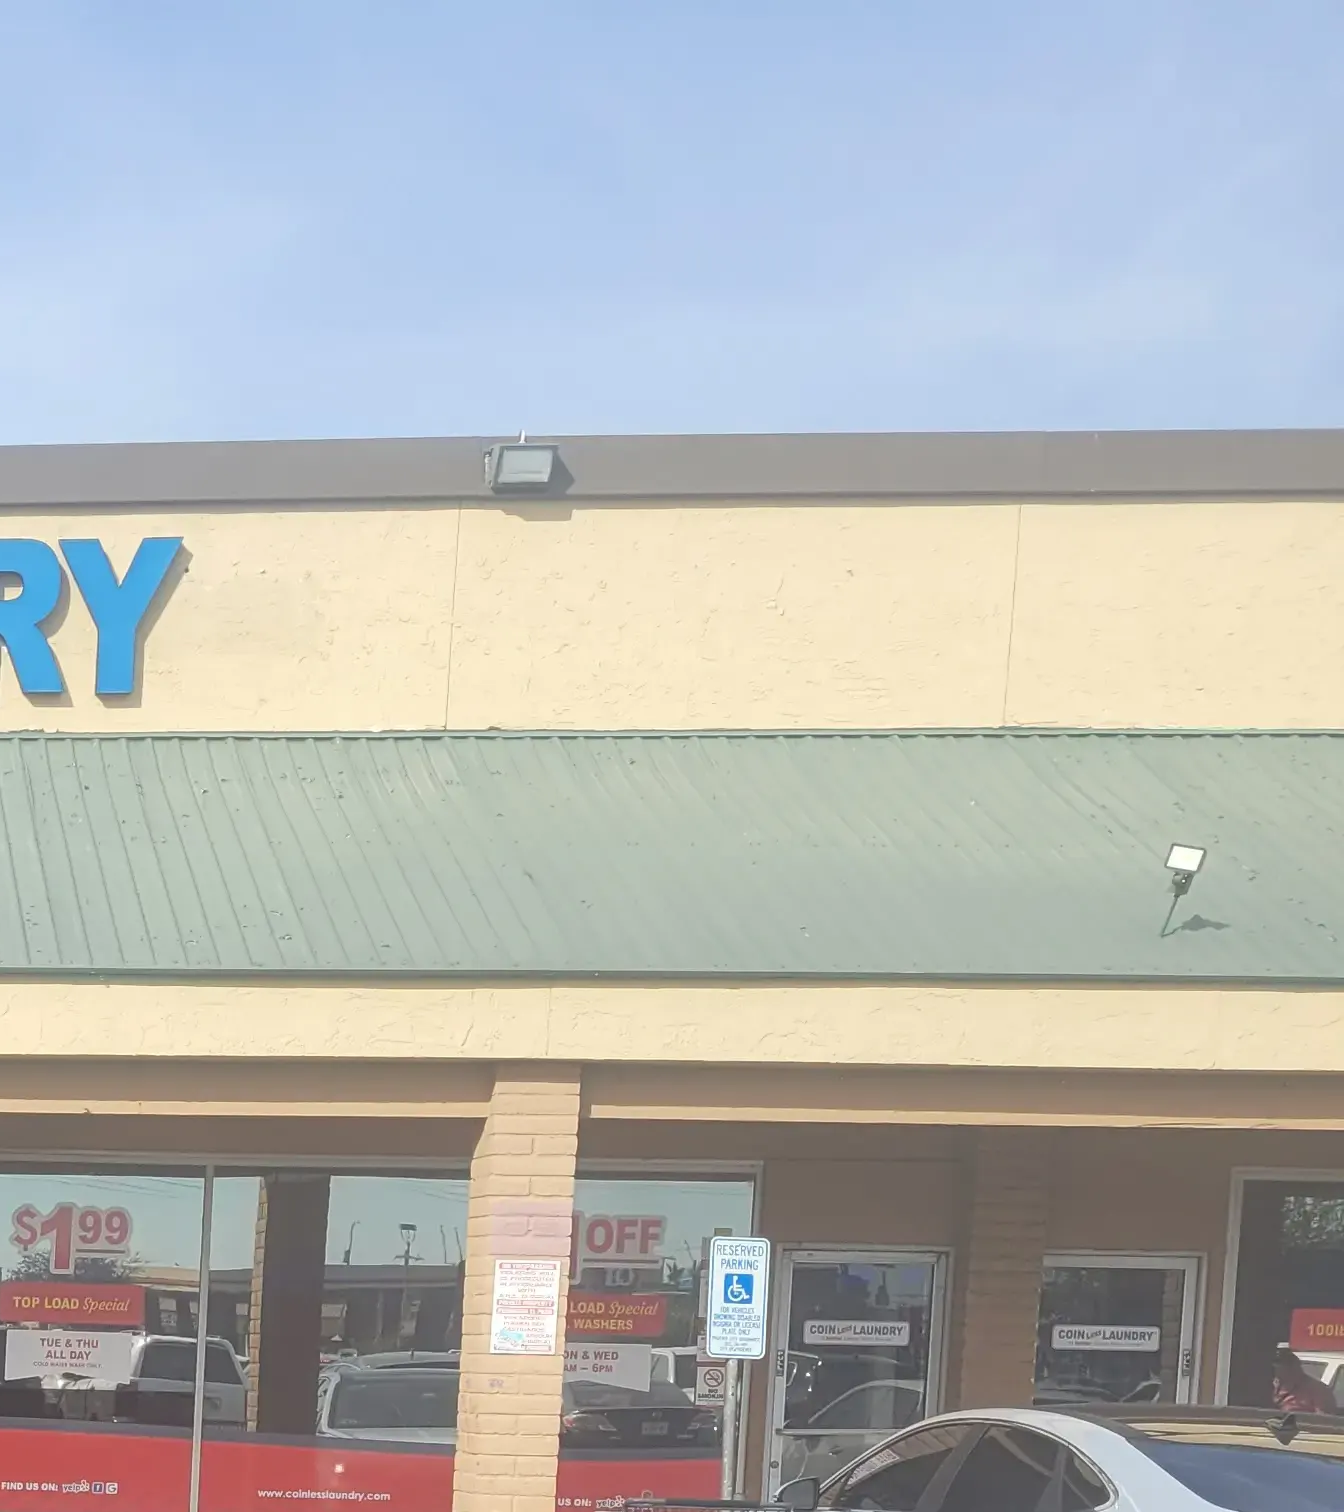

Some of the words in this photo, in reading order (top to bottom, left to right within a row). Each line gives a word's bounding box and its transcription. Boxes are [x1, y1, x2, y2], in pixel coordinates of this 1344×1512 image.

[585, 1218, 662, 1254] OFF
[716, 1244, 765, 1257] RESERVED
[720, 1258, 759, 1271] PARKING
[12, 1296, 40, 1308] TOP
[44, 1297, 79, 1310] LOAD
[82, 1297, 130, 1314] Special
[570, 1302, 605, 1314] LOAD
[608, 1301, 660, 1318] Special
[573, 1319, 633, 1331] WASHERS
[809, 1324, 836, 1335] COIN
[853, 1325, 904, 1336] LAUNDRY
[1058, 1329, 1085, 1340] COIN
[1102, 1330, 1154, 1341] LAUNDRY
[40, 1338, 61, 1348] TUE
[64, 1338, 73, 1348] &
[76, 1339, 99, 1348] THU
[45, 1350, 66, 1360] ALL
[69, 1351, 92, 1361] DAY
[562, 1350, 578, 1360] ON
[581, 1350, 590, 1360] &
[593, 1351, 619, 1361] WED
[563, 1364, 577, 1373] AM
[592, 1363, 613, 1373] 6PM
[1, 1481, 24, 1491] FIND
[25, 1482, 39, 1491] US
[40, 1483, 59, 1491] ON:
[257, 1488, 391, 1502] www.coinlesslaundry.com
[557, 1498, 571, 1507] US
[574, 1498, 592, 1507] ON:
